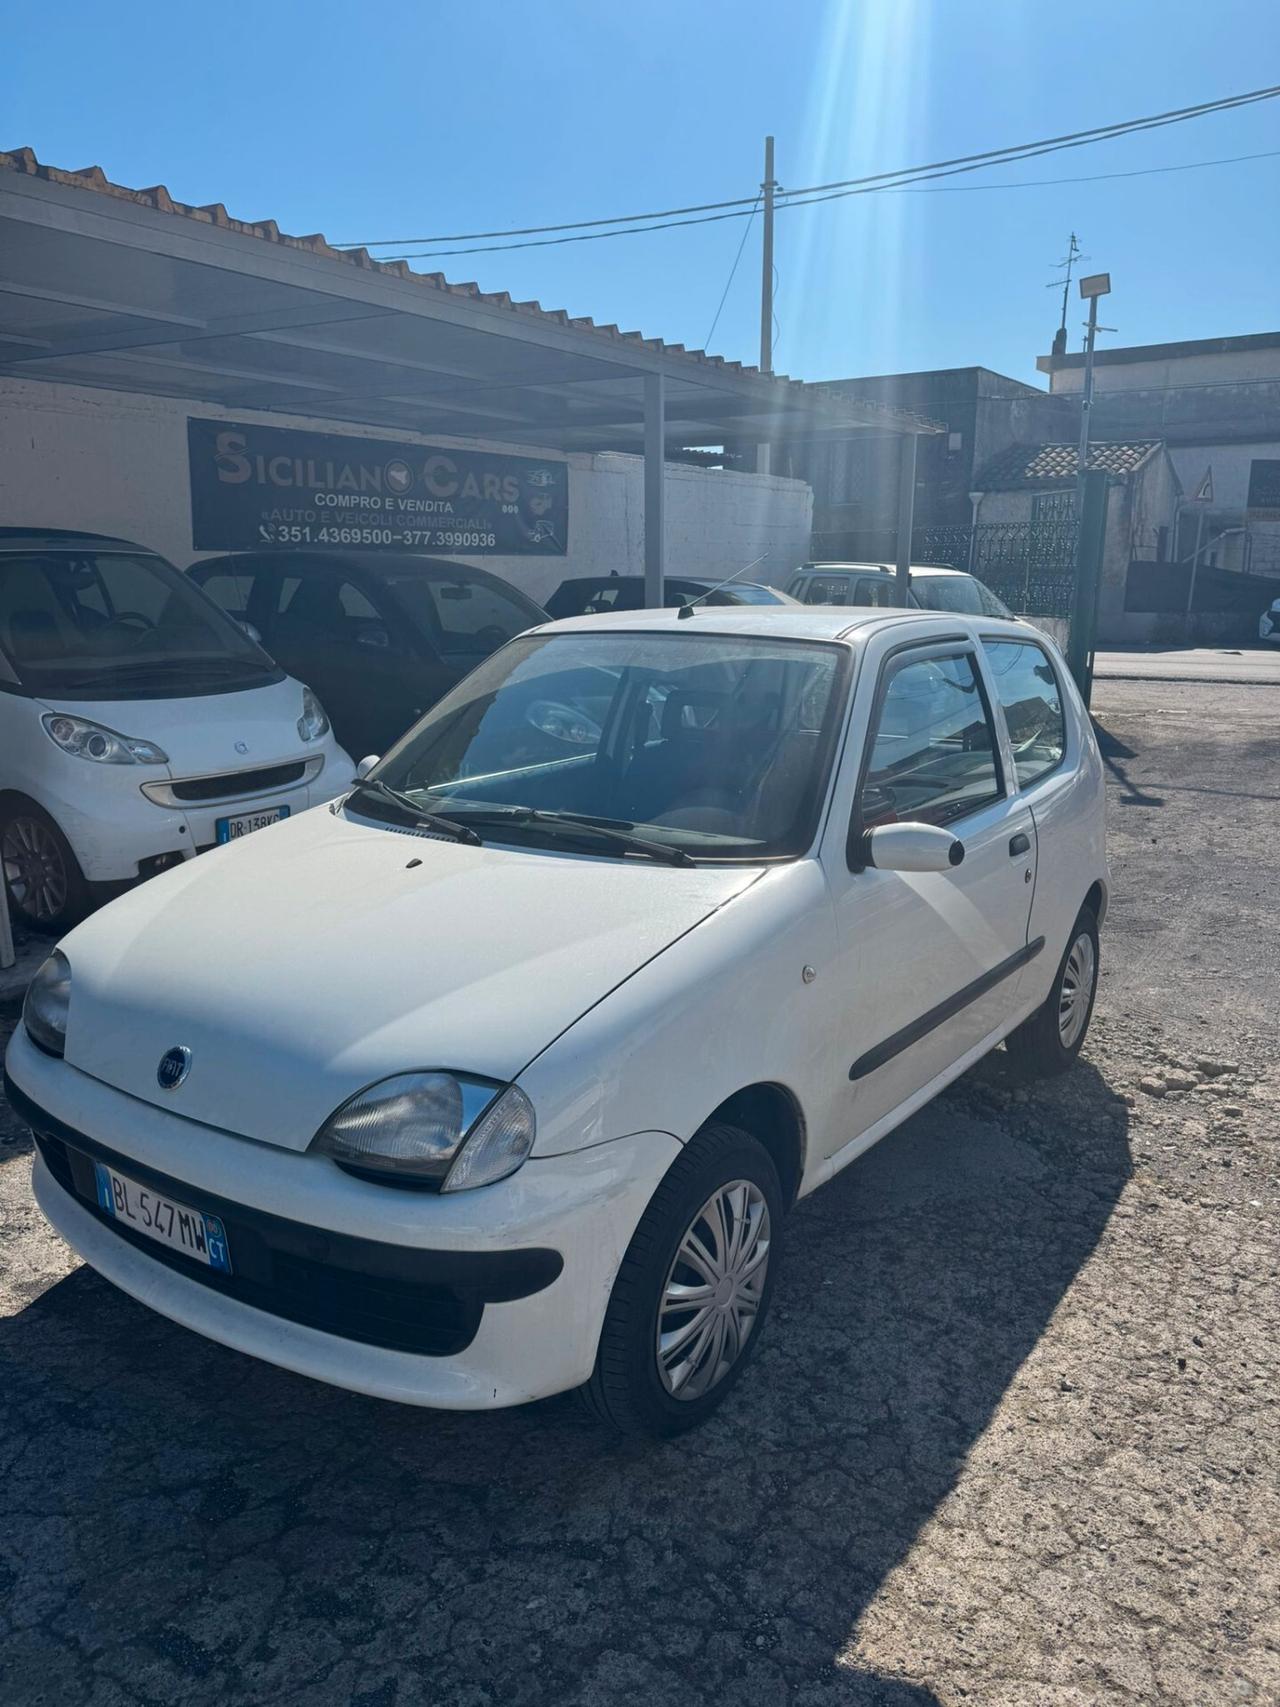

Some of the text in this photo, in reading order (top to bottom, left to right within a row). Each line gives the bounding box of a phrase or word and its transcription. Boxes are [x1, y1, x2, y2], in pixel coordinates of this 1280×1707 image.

[423, 455, 520, 504] CARS
[314, 493, 454, 514] COMPRO E VENDITA
[320, 511, 330, 523] E
[335, 511, 392, 526] VEICOLI
[208, 1238, 227, 1263] CT
